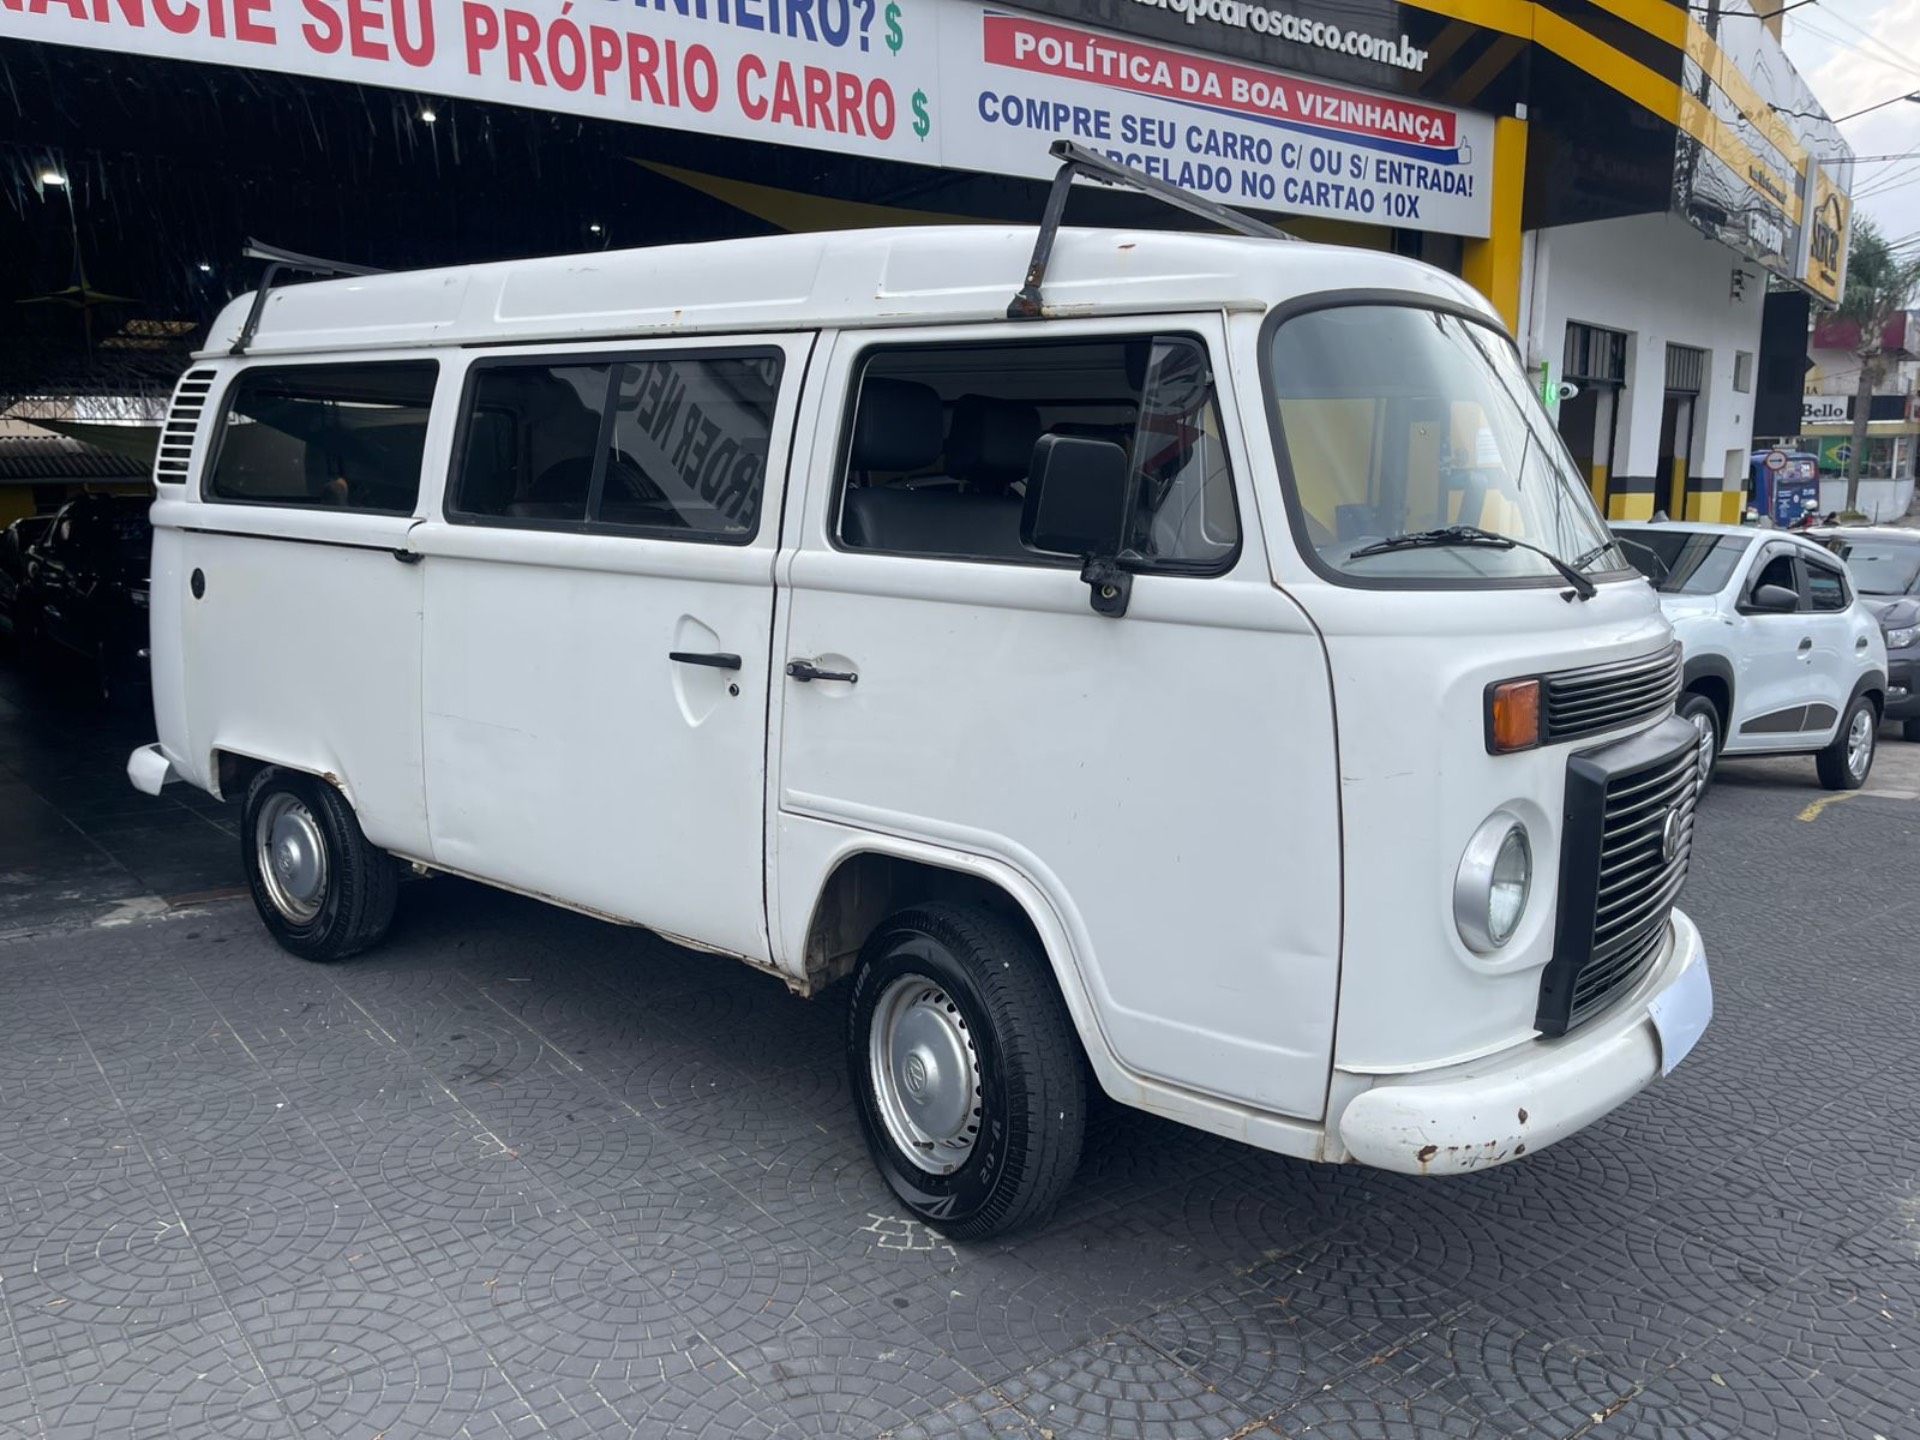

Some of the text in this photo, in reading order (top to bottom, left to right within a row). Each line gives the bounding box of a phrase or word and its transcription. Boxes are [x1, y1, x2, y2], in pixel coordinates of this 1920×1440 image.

[301, 0, 435, 68] SEU
[462, 1, 720, 114] PRÓPRIO
[736, 53, 896, 141] CARRO
[604, 0, 877, 53] EIRO?
[1014, 31, 1446, 143] POLÍTICA DA BOA VIZINHANÇA
[978, 90, 1474, 198] COMPRE SEU CARRO C/ OU S/ ENTRADA!
[1089, 148, 1232, 195] CELADO
[1241, 169, 1276, 200] NO
[1383, 192, 1421, 220] 10X
